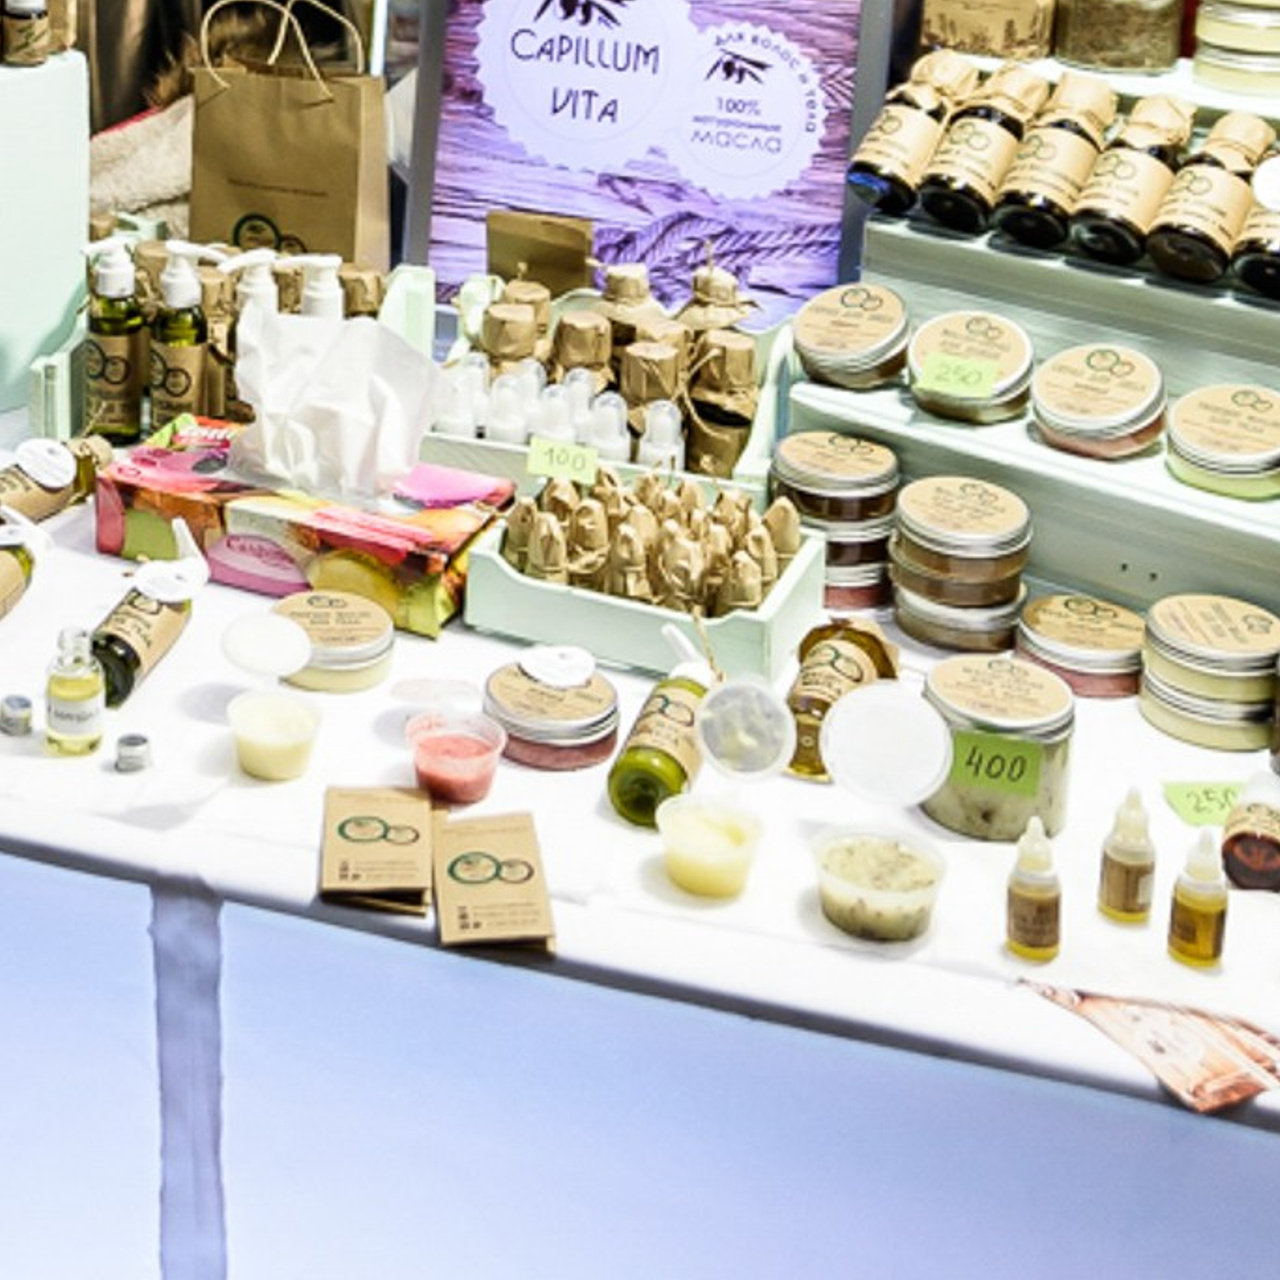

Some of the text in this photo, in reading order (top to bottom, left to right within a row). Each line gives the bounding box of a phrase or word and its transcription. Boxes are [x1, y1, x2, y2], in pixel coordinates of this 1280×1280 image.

[511, 27, 660, 75] CAPILLUM
[551, 86, 619, 123] VITA
[716, 96, 762, 117] 100%
[544, 447, 587, 471] 100
[965, 746, 1027, 782] 400
